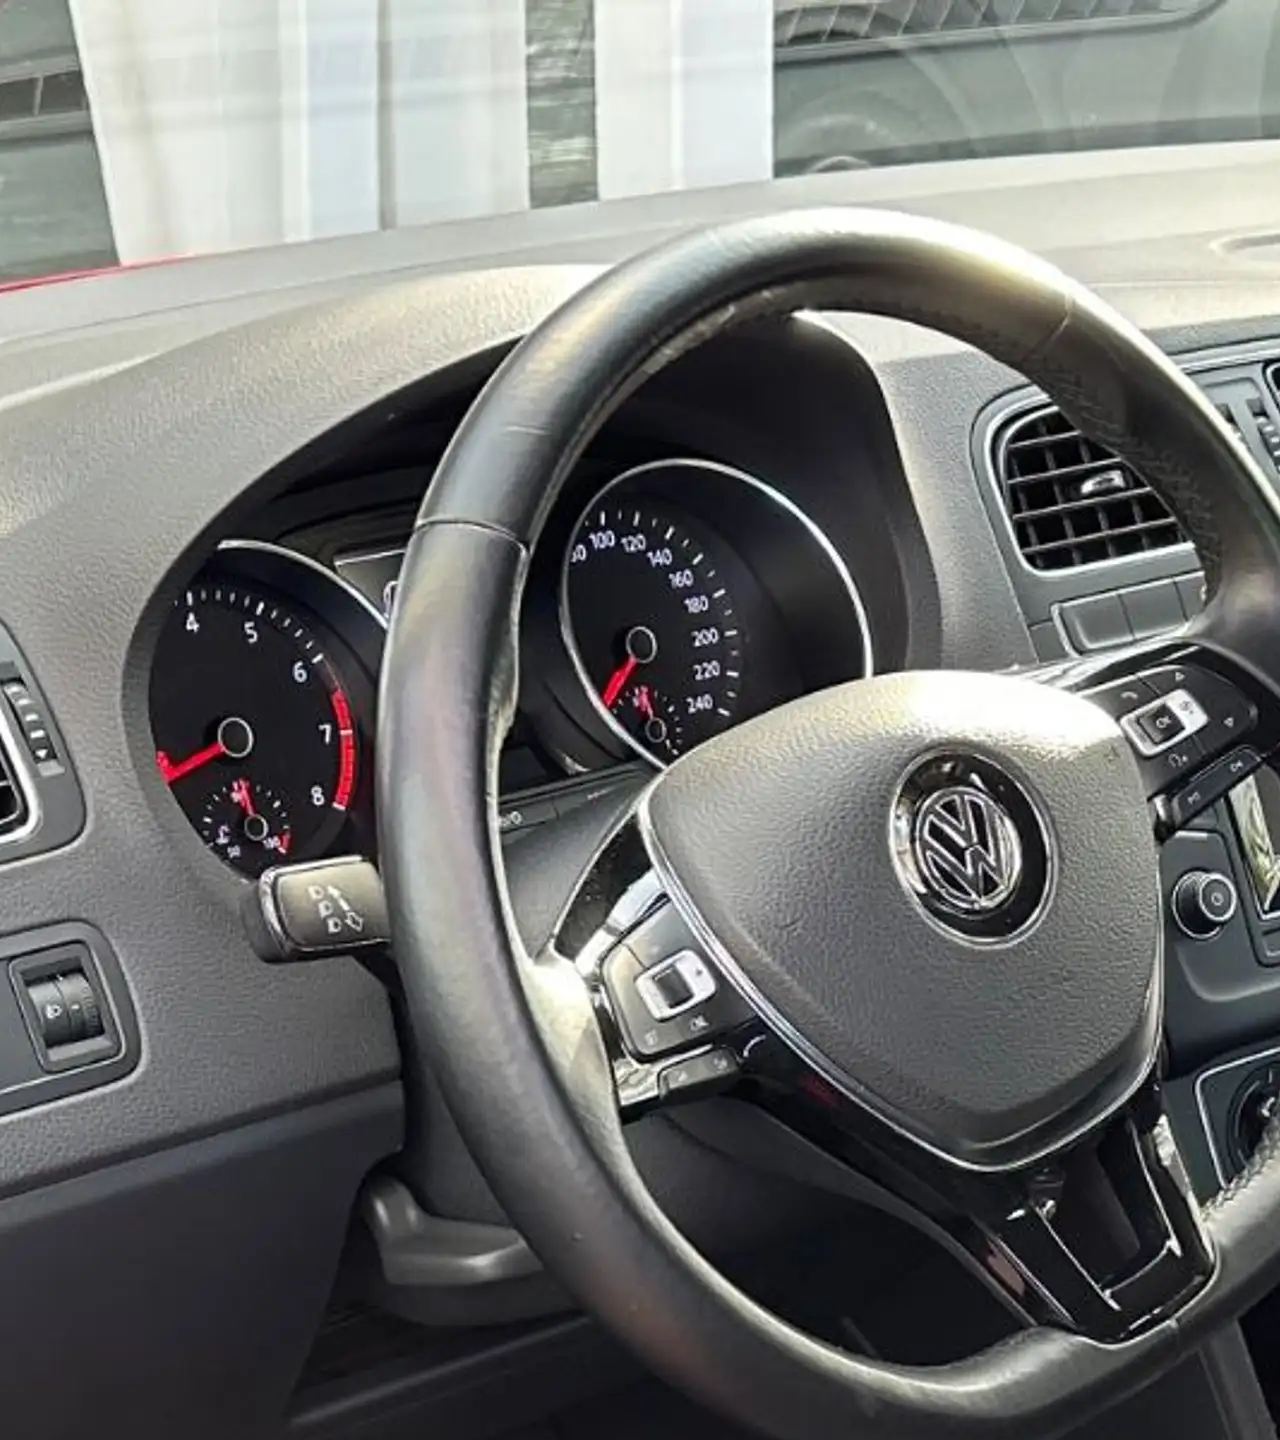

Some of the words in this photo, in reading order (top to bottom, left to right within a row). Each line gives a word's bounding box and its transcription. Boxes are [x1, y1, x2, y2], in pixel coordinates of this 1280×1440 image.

[589, 530, 615, 550] 100
[621, 533, 647, 552] 120
[647, 548, 673, 567] 140
[669, 569, 694, 588] 160
[684, 596, 709, 613] 180
[185, 612, 200, 632] 4
[243, 621, 258, 644] 5
[692, 628, 718, 647] 200
[292, 661, 308, 683] 6
[693, 661, 720, 681] 220
[686, 695, 714, 714] 240
[319, 723, 332, 744] 7
[310, 785, 326, 807] 8
[918, 787, 1020, 908] VW
